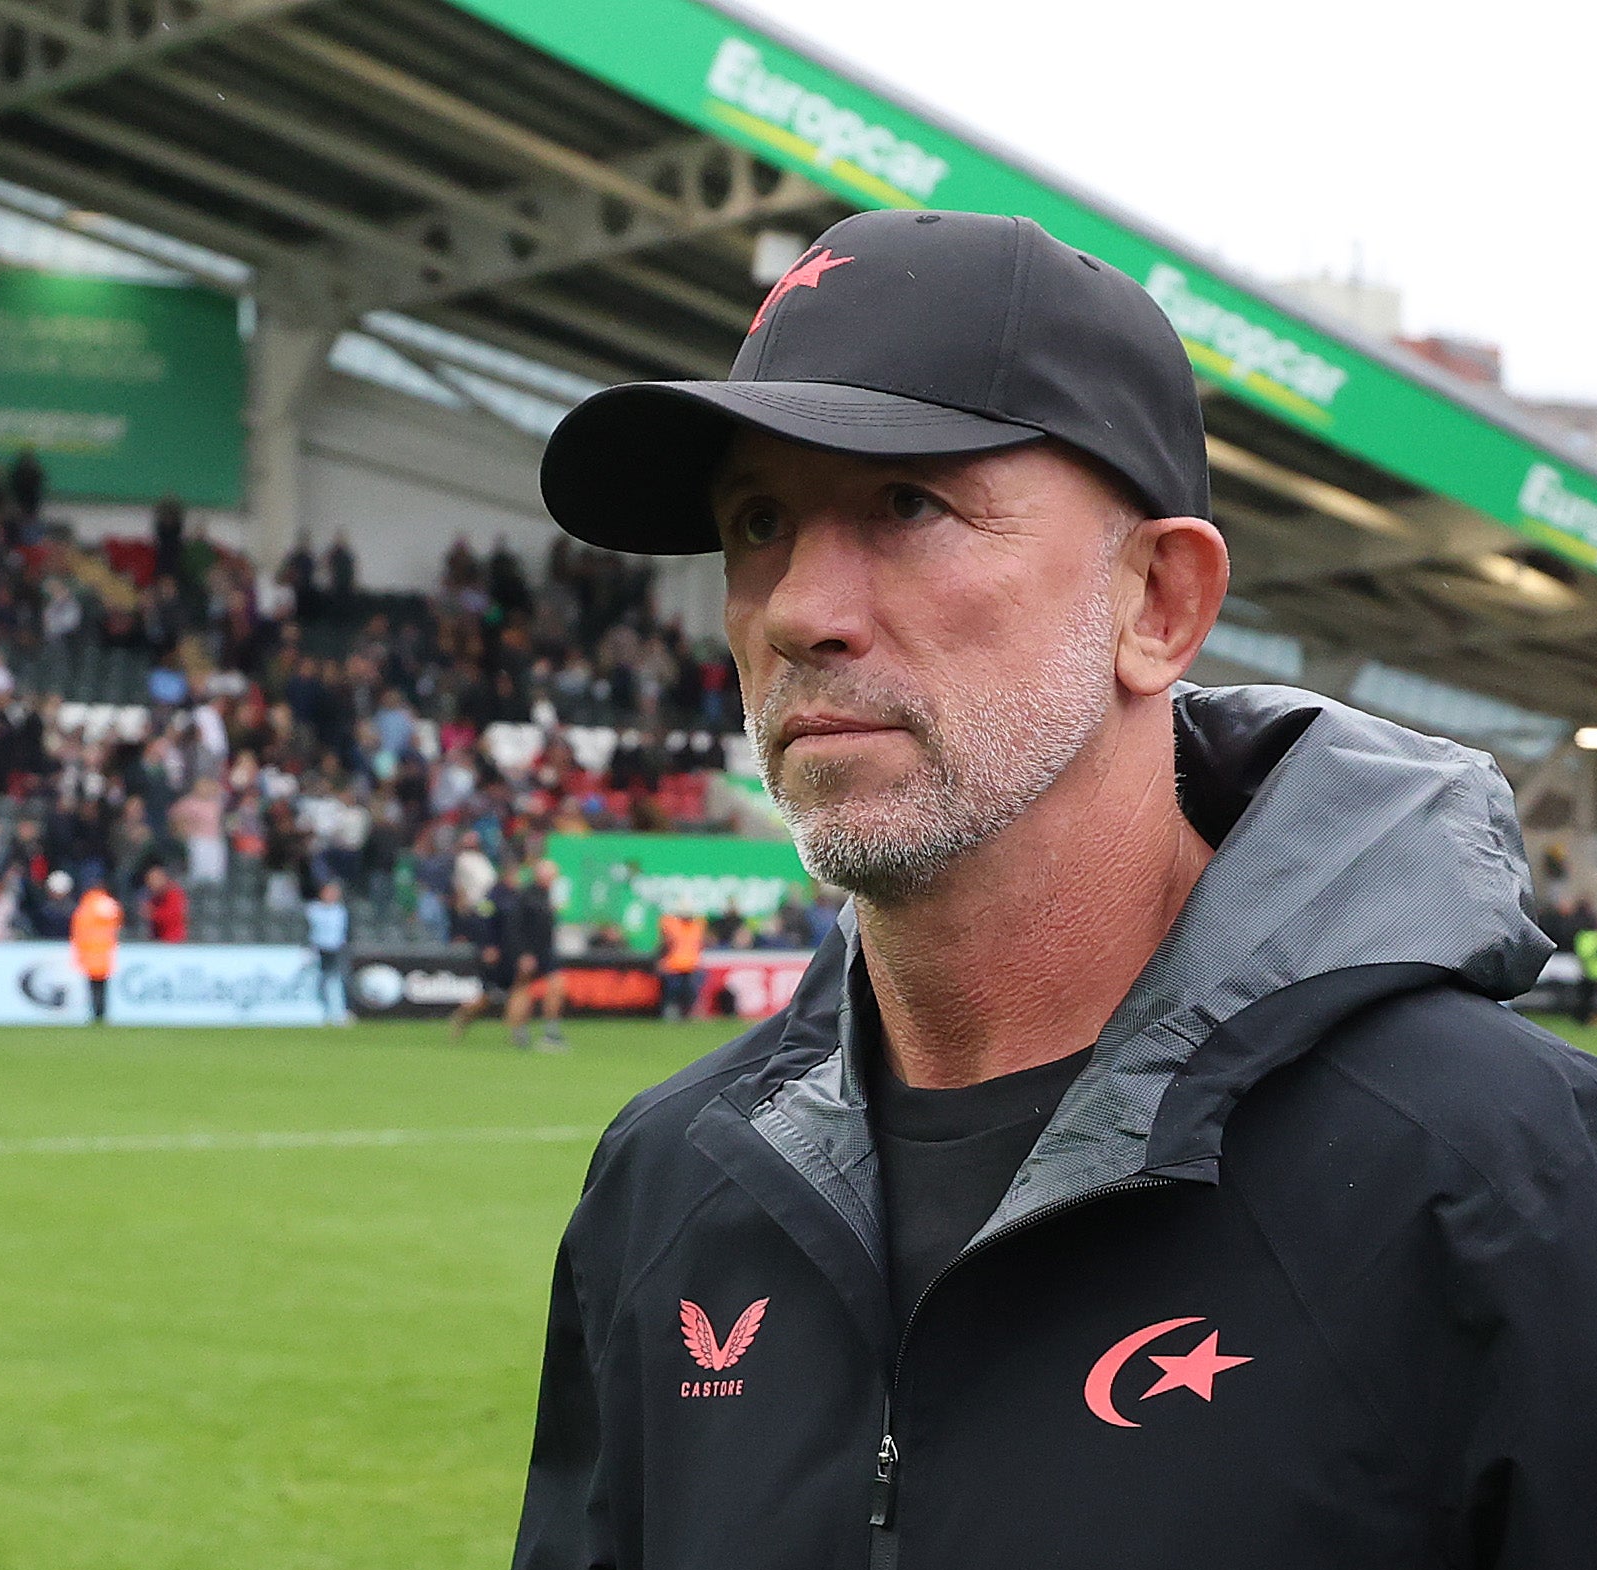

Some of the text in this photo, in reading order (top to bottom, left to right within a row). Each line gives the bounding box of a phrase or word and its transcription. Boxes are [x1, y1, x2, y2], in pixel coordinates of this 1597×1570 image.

[708, 37, 948, 199] Europcar
[1145, 263, 1347, 405] Europcar
[681, 1379, 744, 1398] CASTORE
